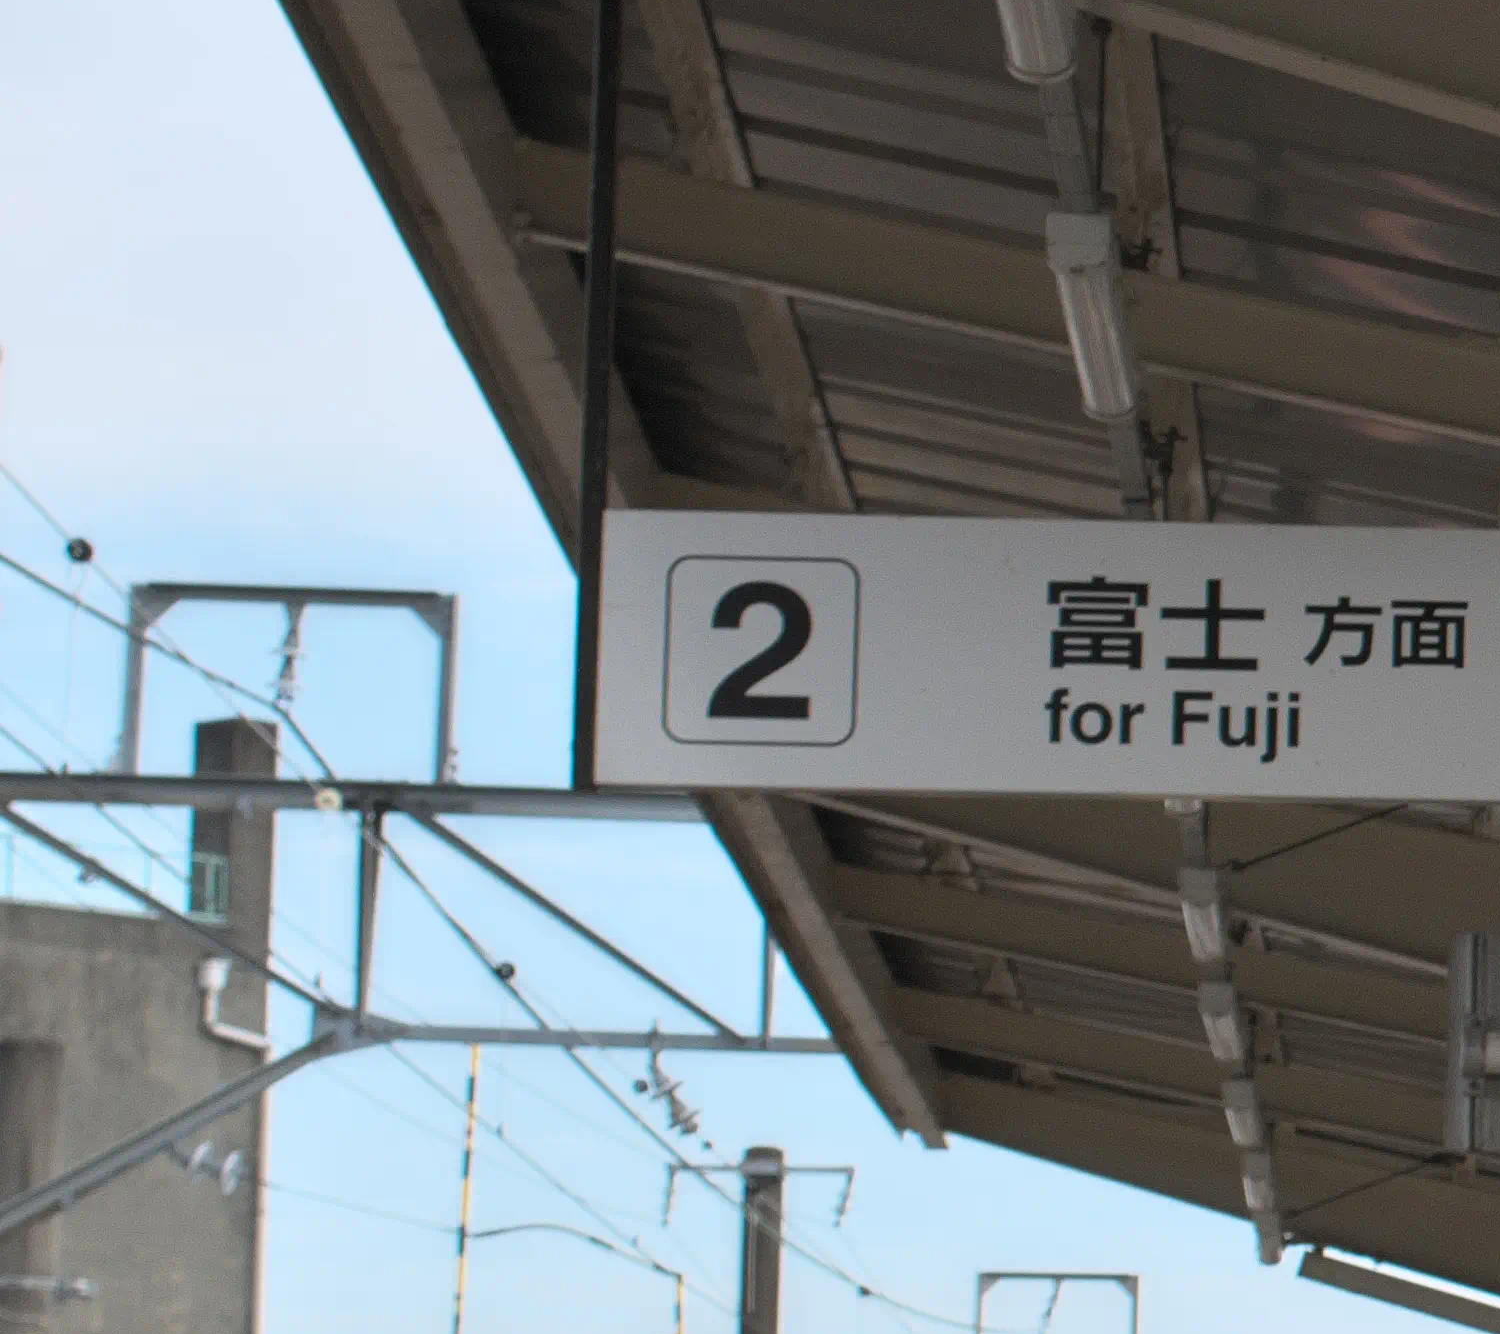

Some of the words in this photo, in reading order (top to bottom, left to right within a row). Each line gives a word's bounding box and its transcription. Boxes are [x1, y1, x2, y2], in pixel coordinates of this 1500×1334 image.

[704, 579, 815, 720] 2
[1044, 687, 1146, 747] for
[1170, 688, 1302, 765] Fuji
